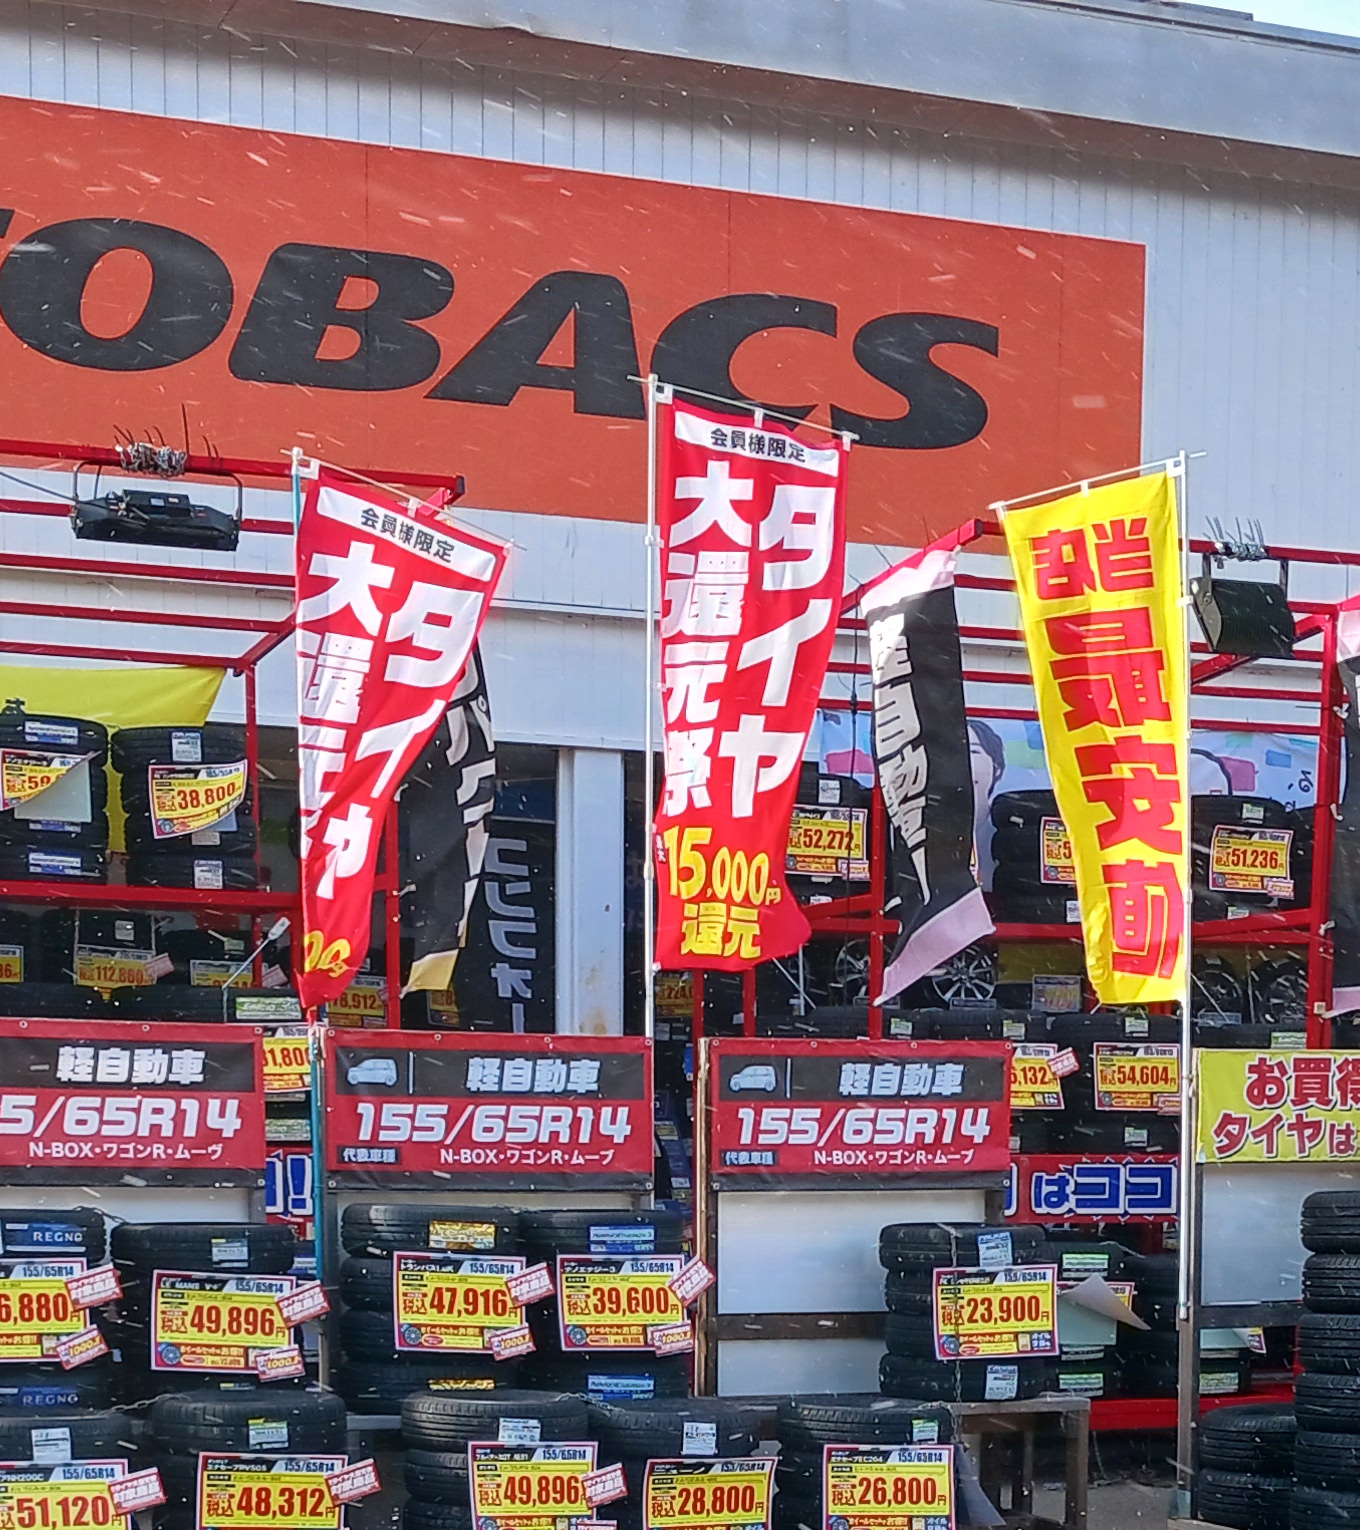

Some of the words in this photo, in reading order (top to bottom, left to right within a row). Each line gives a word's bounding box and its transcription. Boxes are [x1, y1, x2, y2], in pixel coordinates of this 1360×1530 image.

[710, 429, 806, 464] 会員様限定
[361, 508, 455, 564] 会員様限定
[662, 460, 753, 818] 大還元祭
[718, 485, 836, 818] タイヤ
[330, 583, 485, 899] タイヤ
[681, 903, 761, 958] 還元
[56, 1046, 207, 1085] 軽自動車
[466, 1057, 601, 1094] 軽自動車
[839, 1062, 964, 1096] 軽自動車
[356, 1103, 632, 1144] 155/65R14
[738, 1108, 990, 1146] 155/65R14
[32, 1231, 84, 1242] REGNO
[22, 1266, 74, 1278] 155/65R14
[235, 1281, 284, 1294] 155/65R14
[592, 1286, 680, 1317] 39,600円
[966, 1294, 1050, 1326] 23,900円
[190, 1304, 287, 1338] 49,896円
[22, 1393, 79, 1404] REGNO
[62, 1467, 116, 1480] 155/65R14
[284, 1461, 335, 1472] 155/65R14
[237, 1486, 336, 1519] 48,312円
[677, 1485, 764, 1518] 28,800円
[858, 1476, 947, 1508] 26,800円
